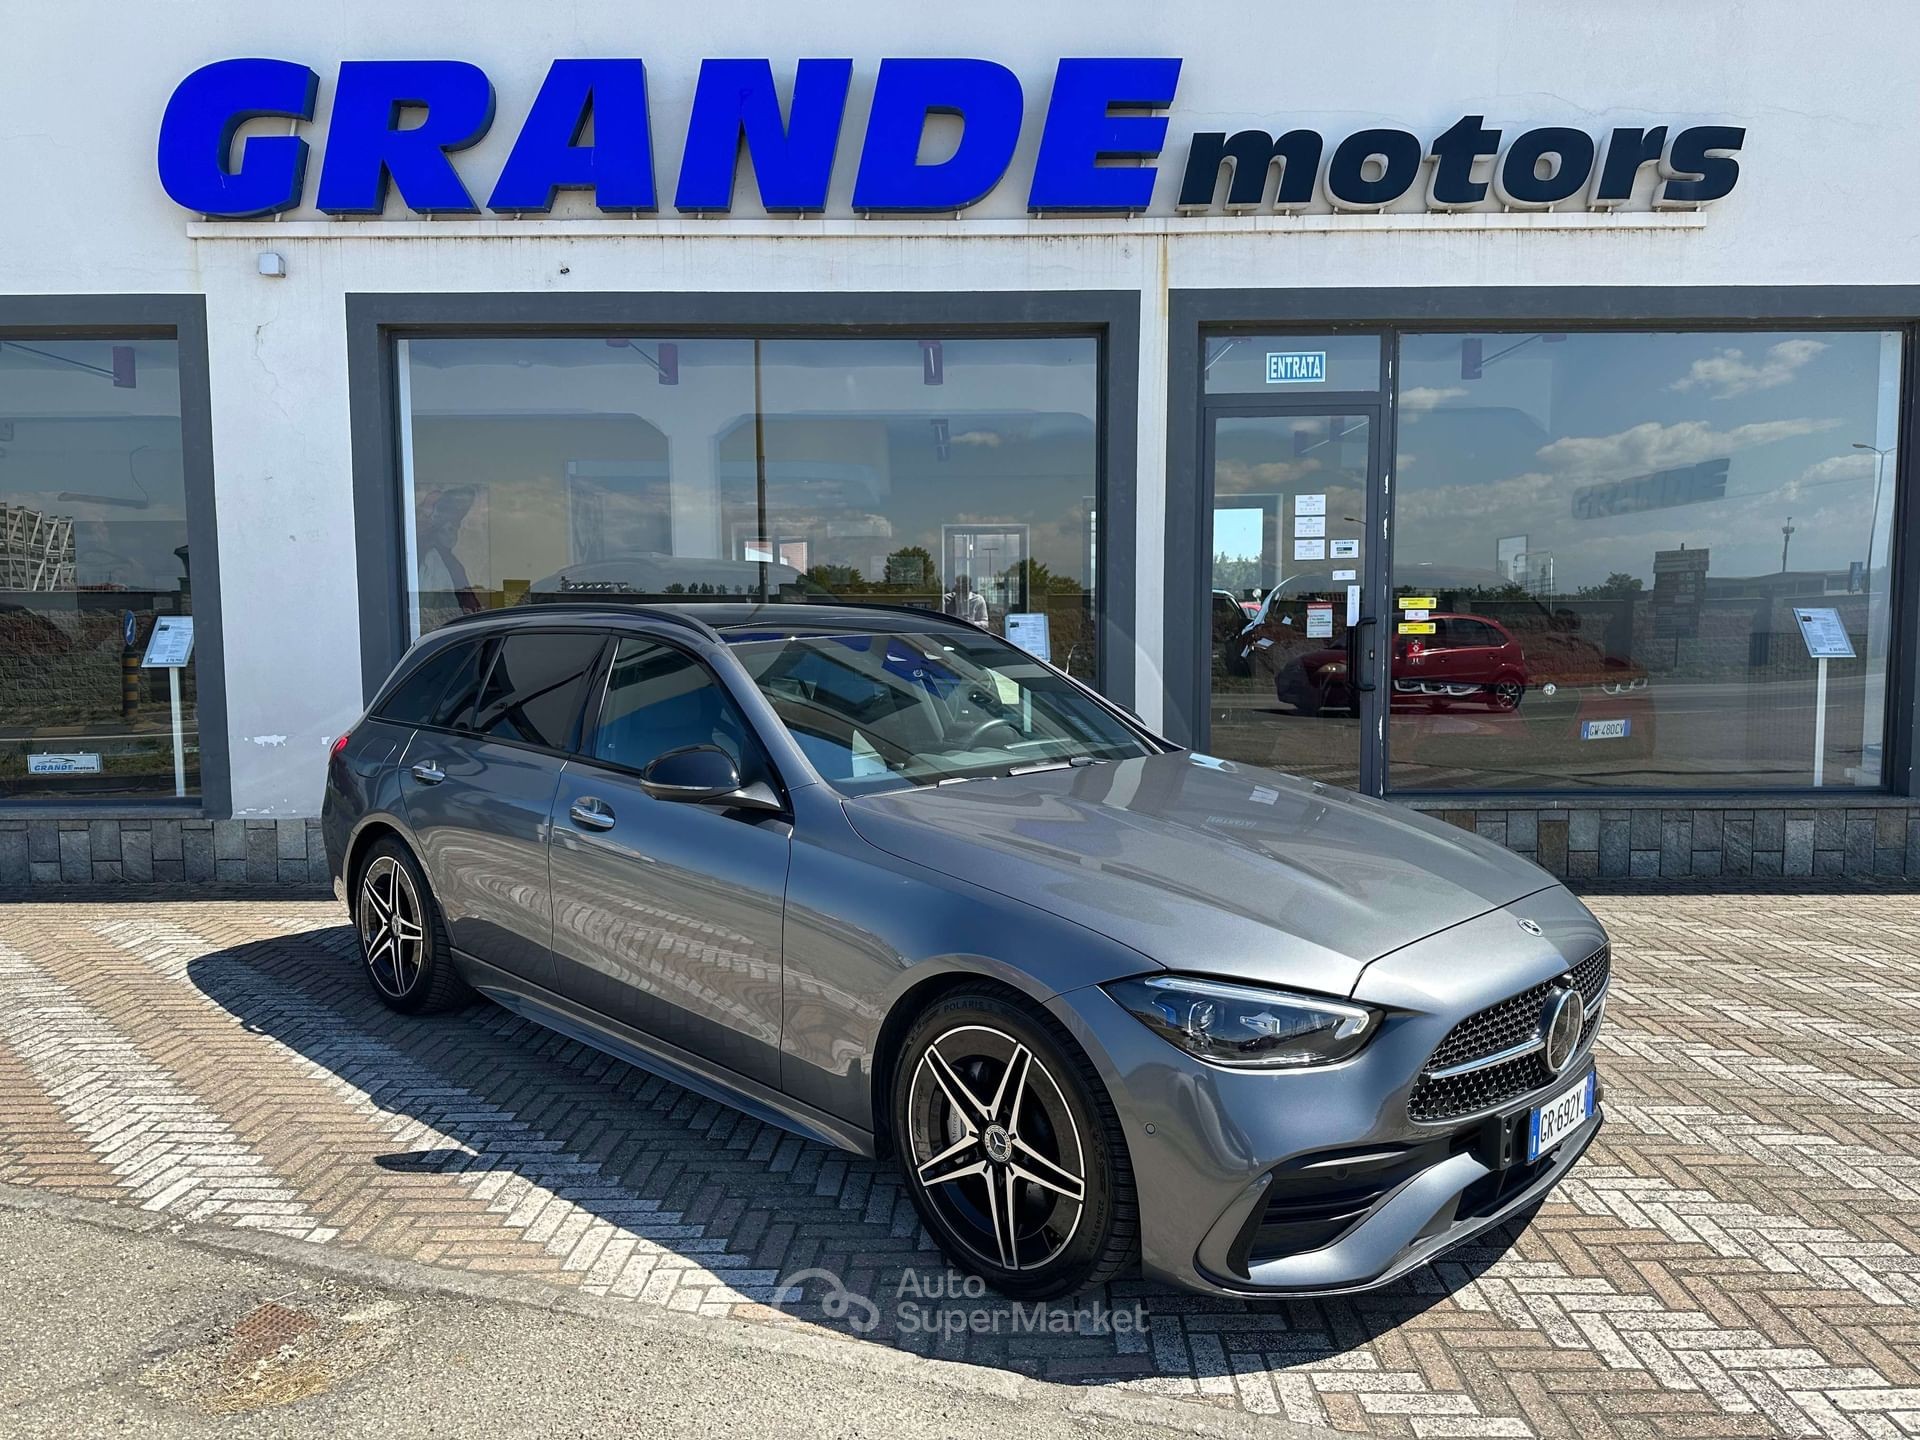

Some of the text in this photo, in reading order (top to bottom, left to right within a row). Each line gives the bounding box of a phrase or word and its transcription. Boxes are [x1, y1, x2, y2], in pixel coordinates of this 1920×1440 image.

[158, 57, 1746, 218] GRANDE motors
[1270, 356, 1321, 378] ENTRATA
[34, 763, 74, 771] GRANDE
